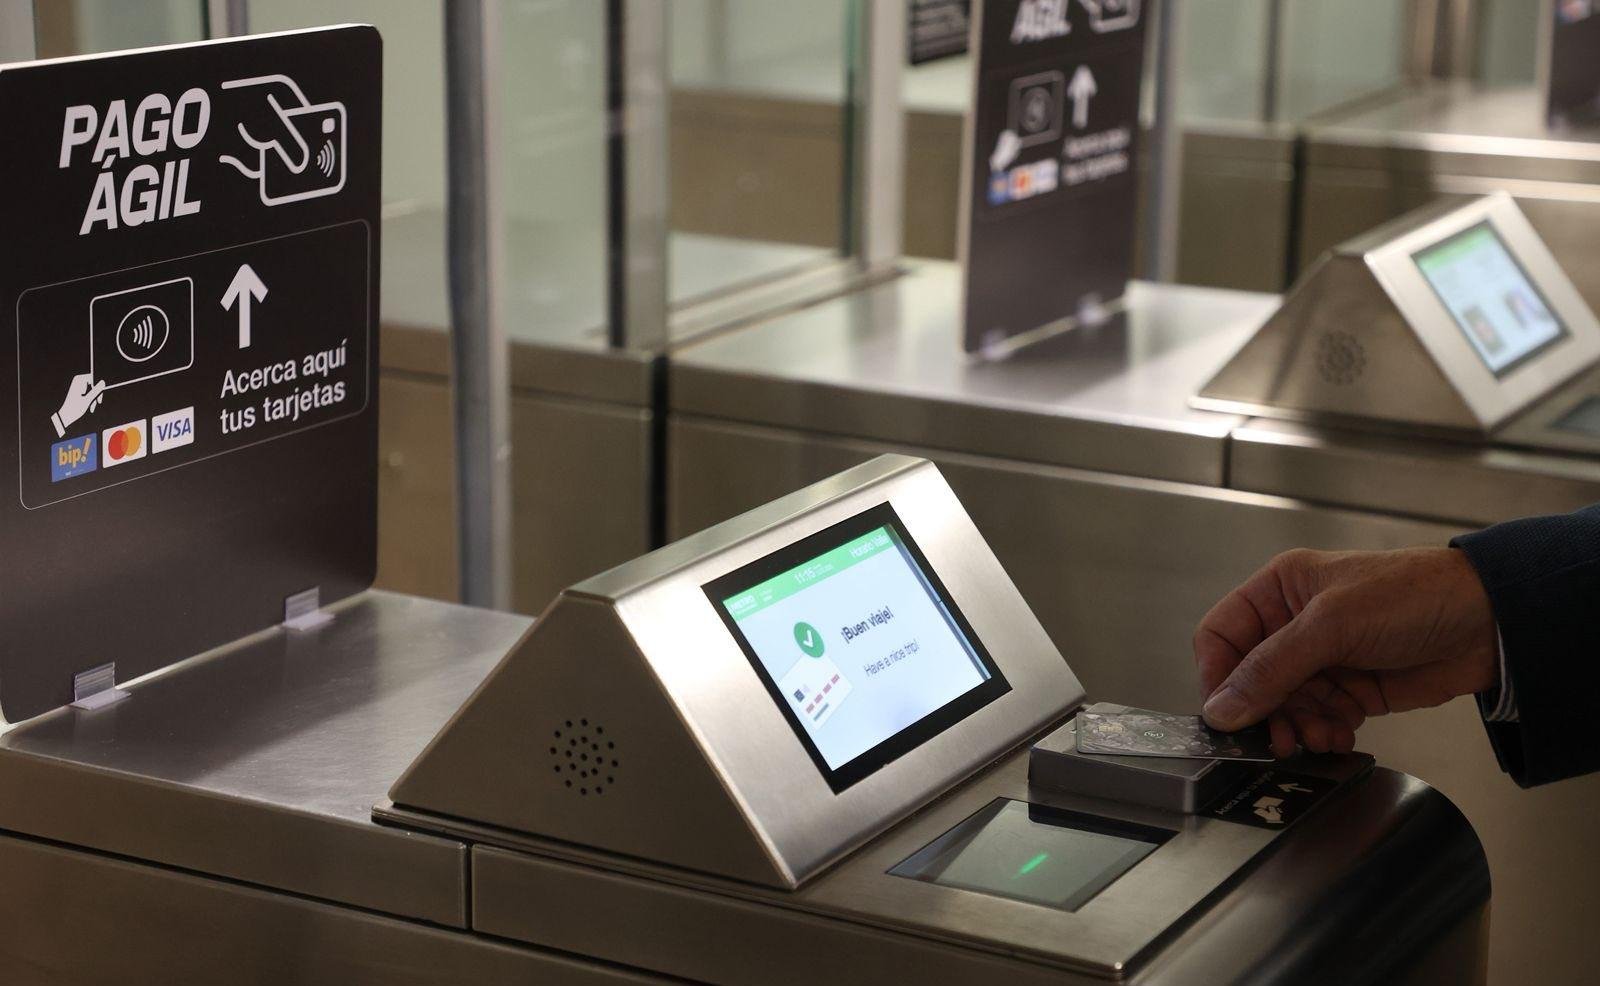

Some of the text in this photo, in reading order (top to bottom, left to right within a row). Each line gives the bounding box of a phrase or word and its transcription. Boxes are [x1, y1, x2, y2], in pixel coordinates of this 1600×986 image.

[59, 87, 211, 168] PAGO
[79, 154, 202, 236] ÁGIL
[220, 338, 347, 399] Acerca aquí
[157, 417, 192, 442] VISA
[219, 381, 346, 435] tus tarjetas
[58, 437, 91, 469] bip!
[841, 605, 894, 644] ¡Buen viaje!
[863, 660, 885, 677] Have
[884, 657, 891, 667] a
[889, 648, 906, 664] nice
